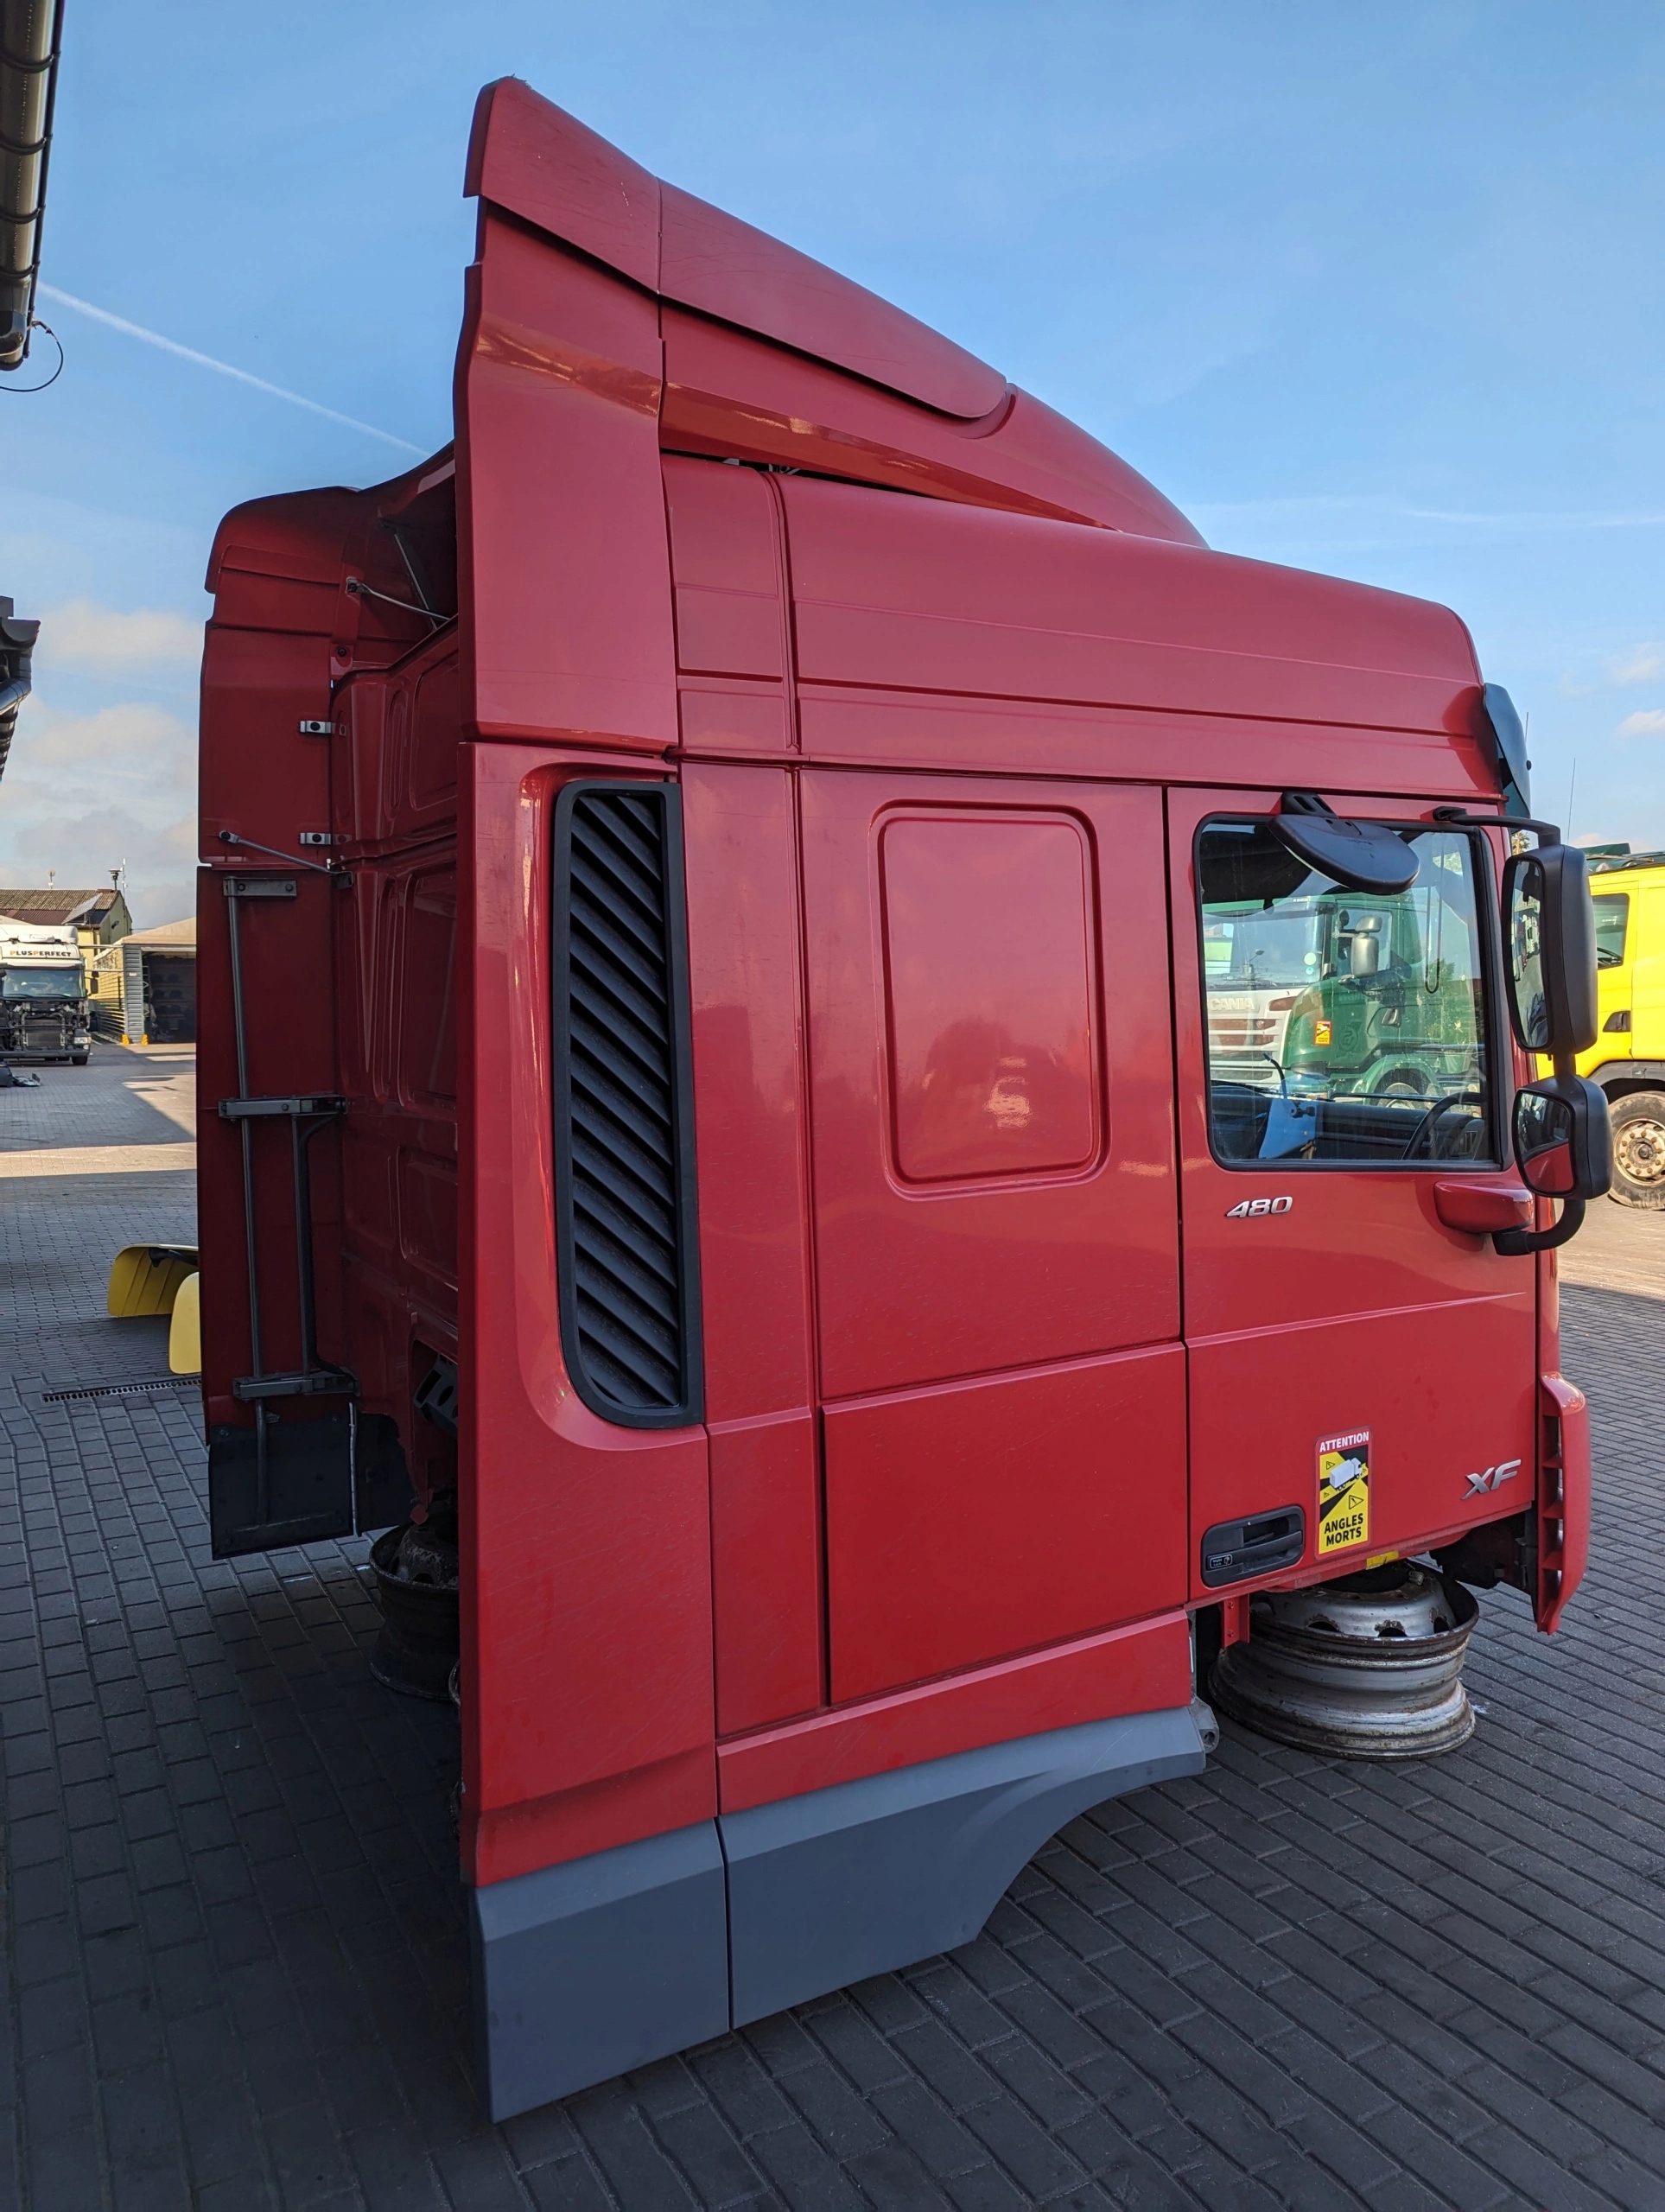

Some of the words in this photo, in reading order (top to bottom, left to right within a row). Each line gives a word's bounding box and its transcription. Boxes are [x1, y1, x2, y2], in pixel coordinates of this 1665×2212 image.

[1207, 998, 1255, 1011] CANIA
[1226, 1196, 1293, 1217] 480
[1319, 1431, 1369, 1453] ATTENTION
[1460, 1459, 1522, 1500] XF
[1324, 1512, 1364, 1534] ANGLES
[1325, 1527, 1362, 1547] MORTS
